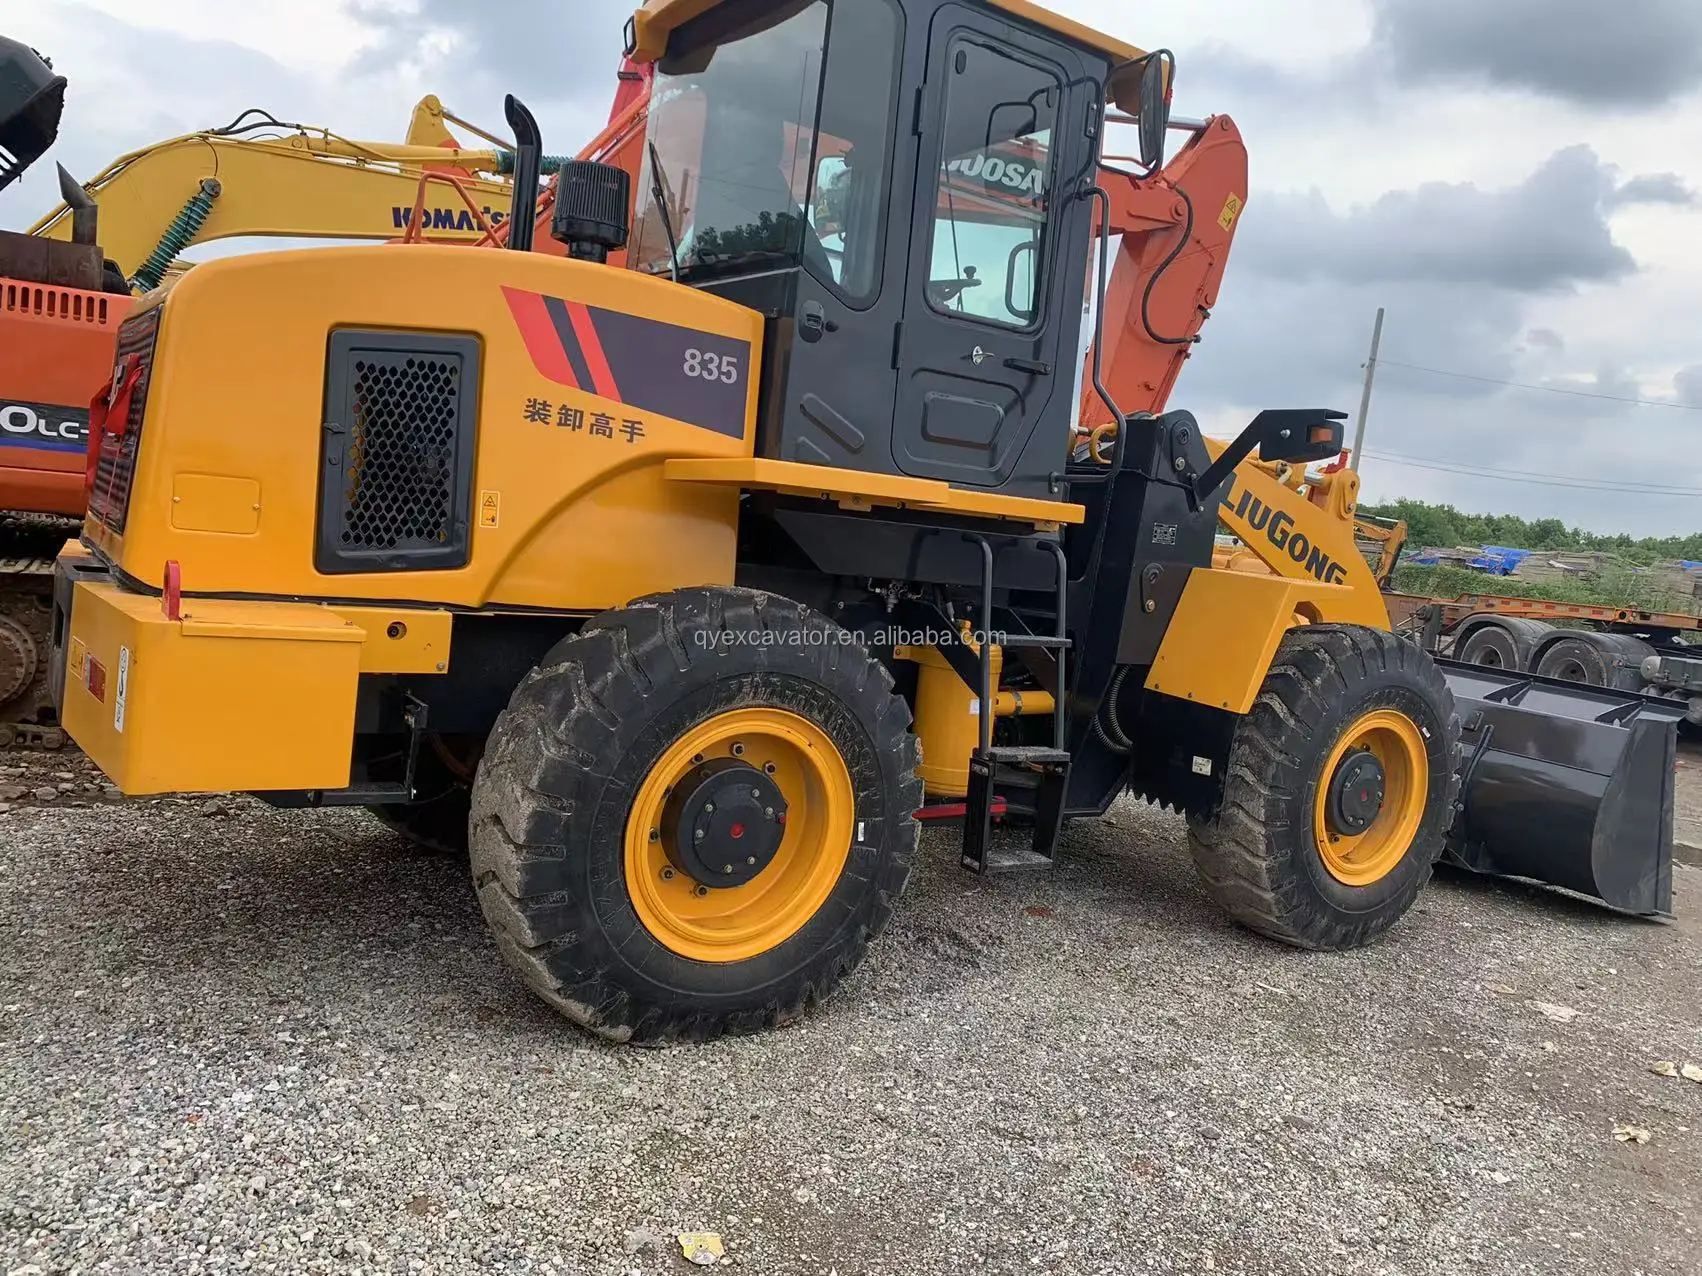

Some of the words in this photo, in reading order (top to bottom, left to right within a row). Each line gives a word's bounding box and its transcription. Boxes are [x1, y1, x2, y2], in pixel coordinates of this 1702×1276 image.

[392, 207, 511, 231] KOMATS
[683, 348, 738, 384] 835
[523, 397, 646, 443] 装卸高手
